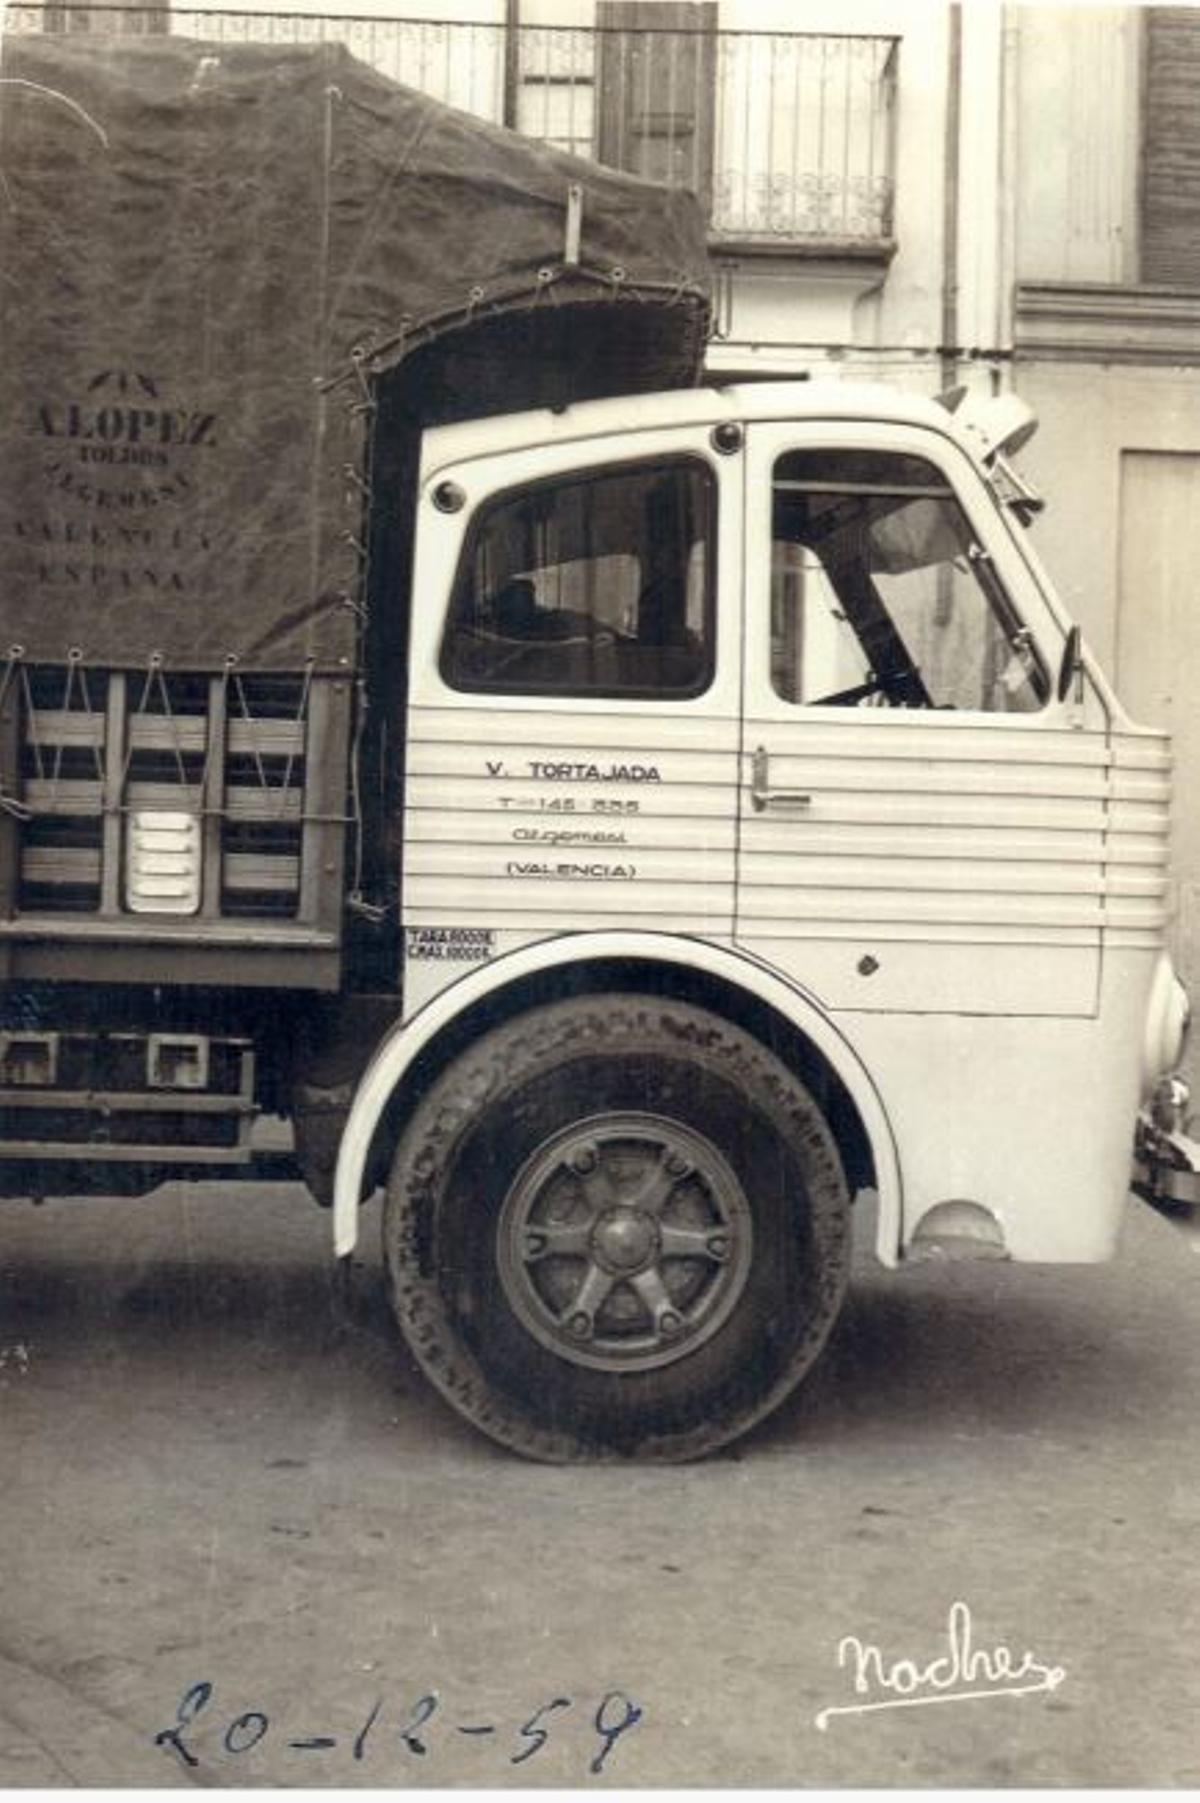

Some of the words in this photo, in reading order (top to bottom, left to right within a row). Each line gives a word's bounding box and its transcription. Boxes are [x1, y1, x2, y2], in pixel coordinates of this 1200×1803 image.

[485, 761, 508, 777] V.
[529, 762, 661, 781] TORTAJADA
[506, 861, 636, 879] (VALENCIA)
